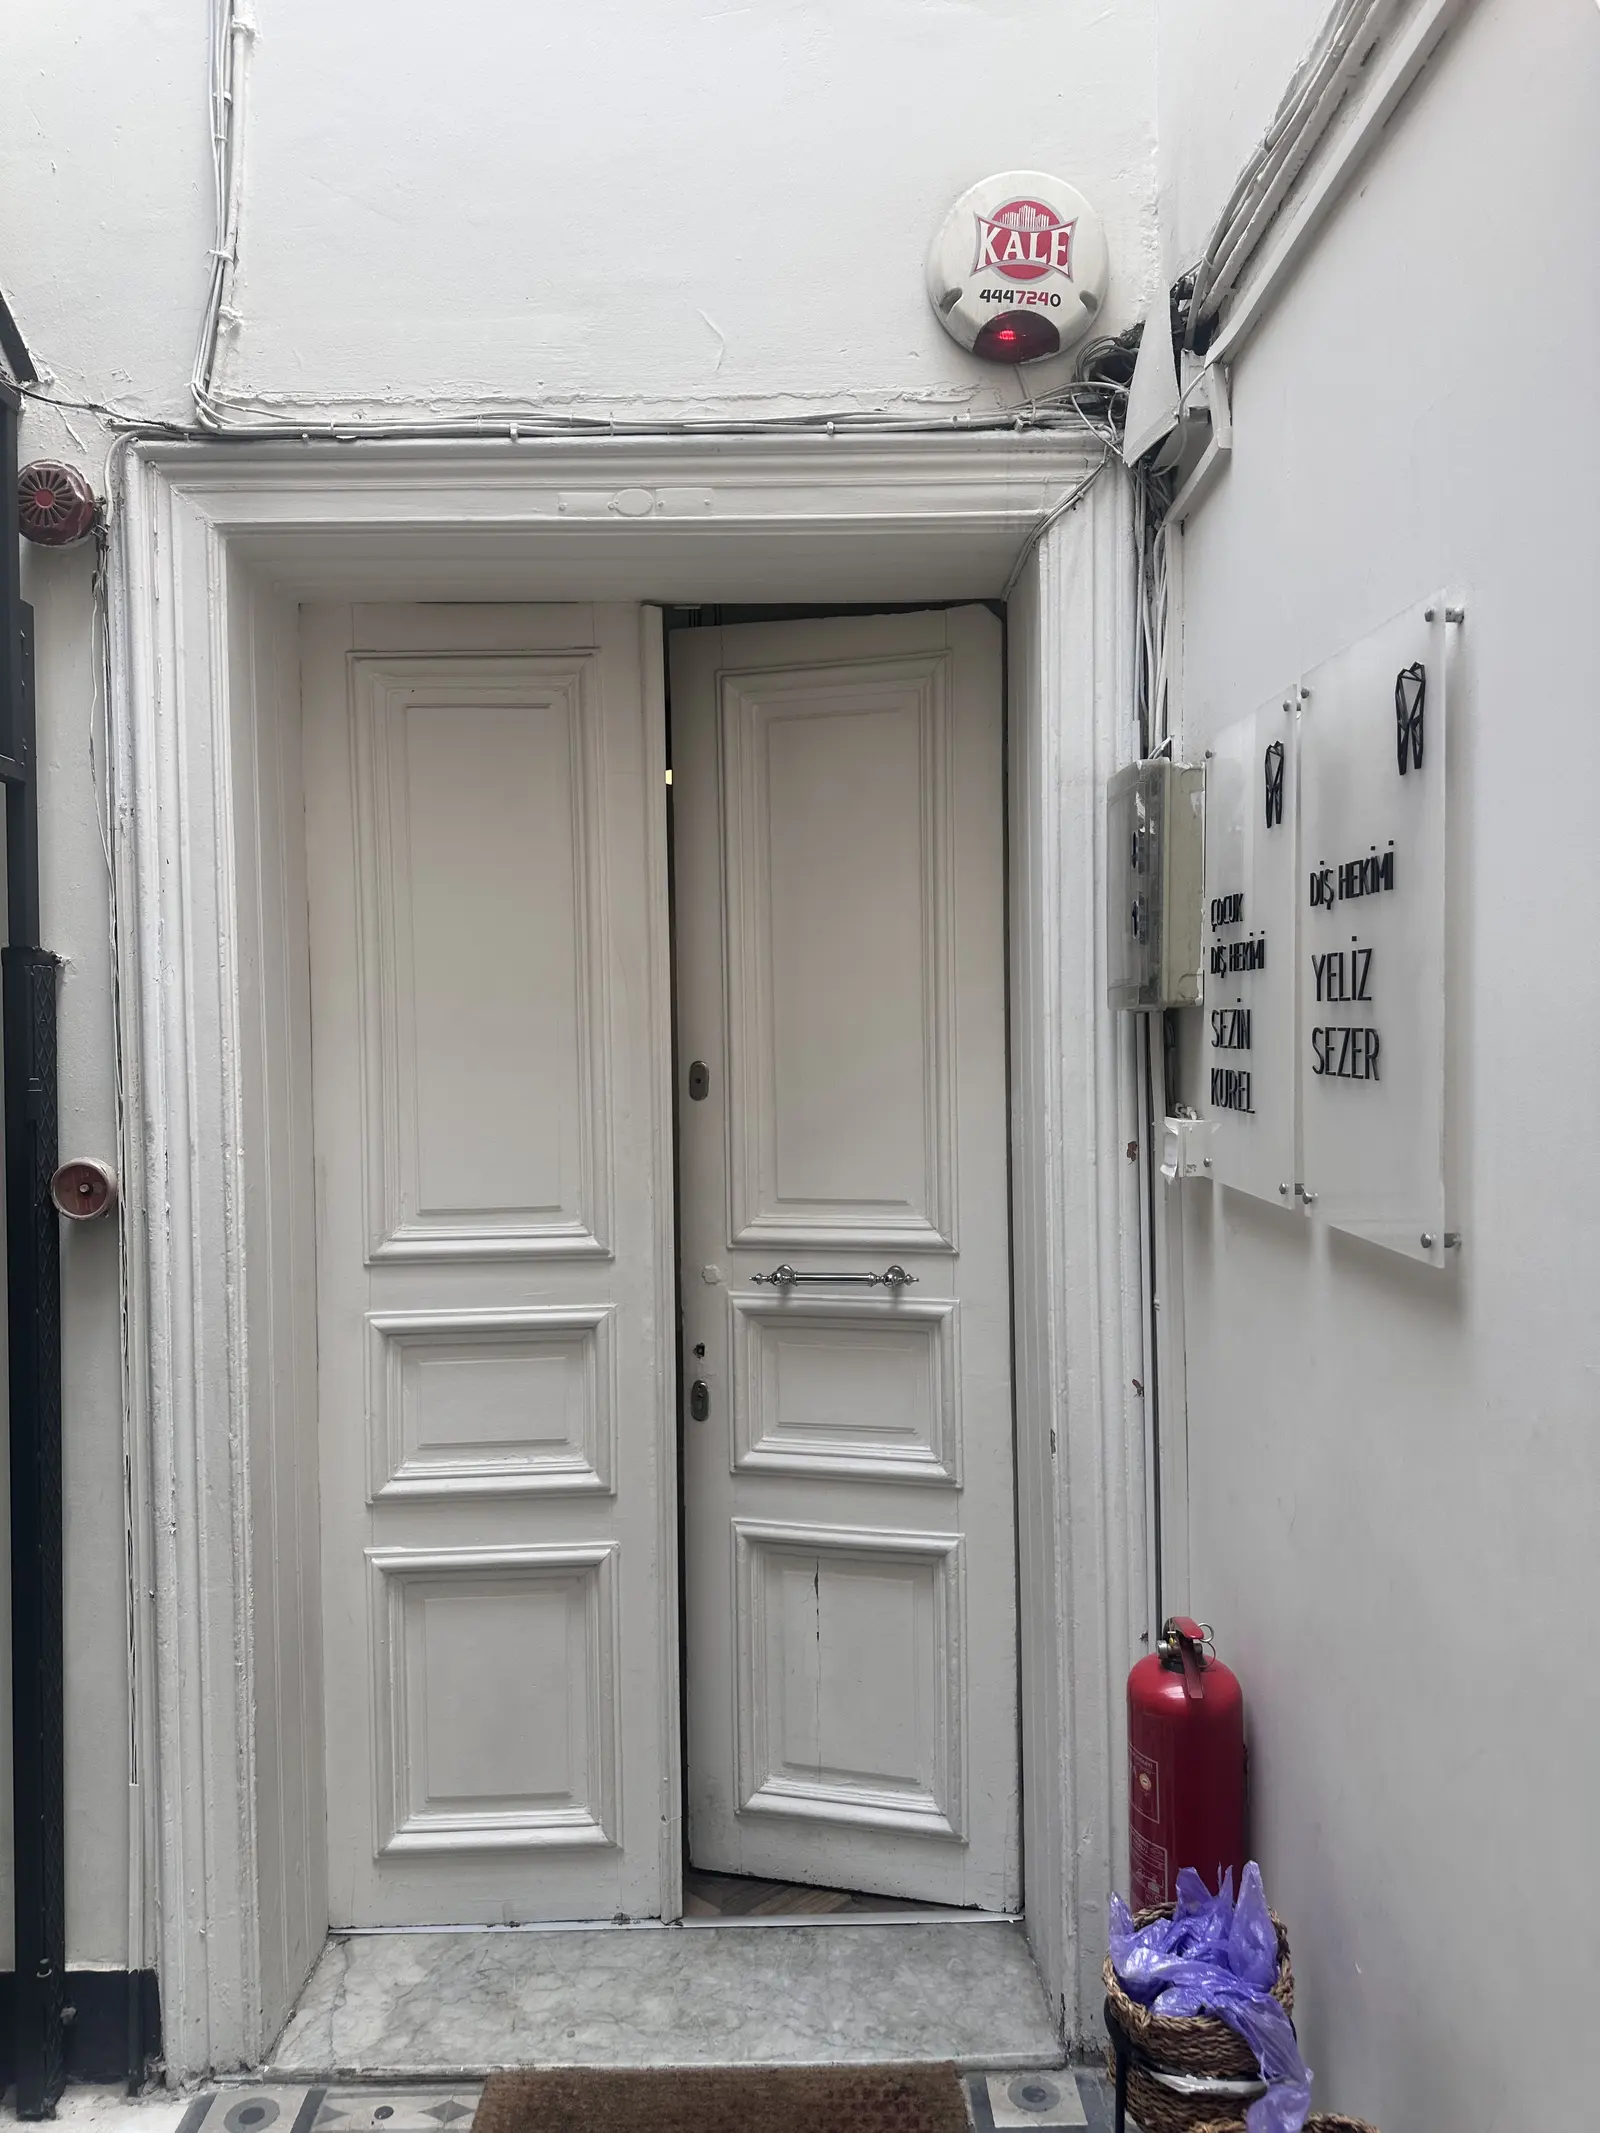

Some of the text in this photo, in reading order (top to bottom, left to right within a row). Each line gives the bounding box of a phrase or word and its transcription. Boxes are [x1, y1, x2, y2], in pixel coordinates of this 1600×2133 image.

[976, 220, 1072, 274] KALE
[1309, 840, 1394, 911] DİŞ HEKİMİ
[1210, 893, 1244, 933] ÇOCUK
[1210, 930, 1265, 979] DİŞ HEKİMİ
[1311, 936, 1373, 1002] YELİZ
[1211, 997, 1251, 1050] SEZİN
[1312, 1027, 1380, 1081] SEZER
[1210, 1067, 1256, 1115] KUREL
